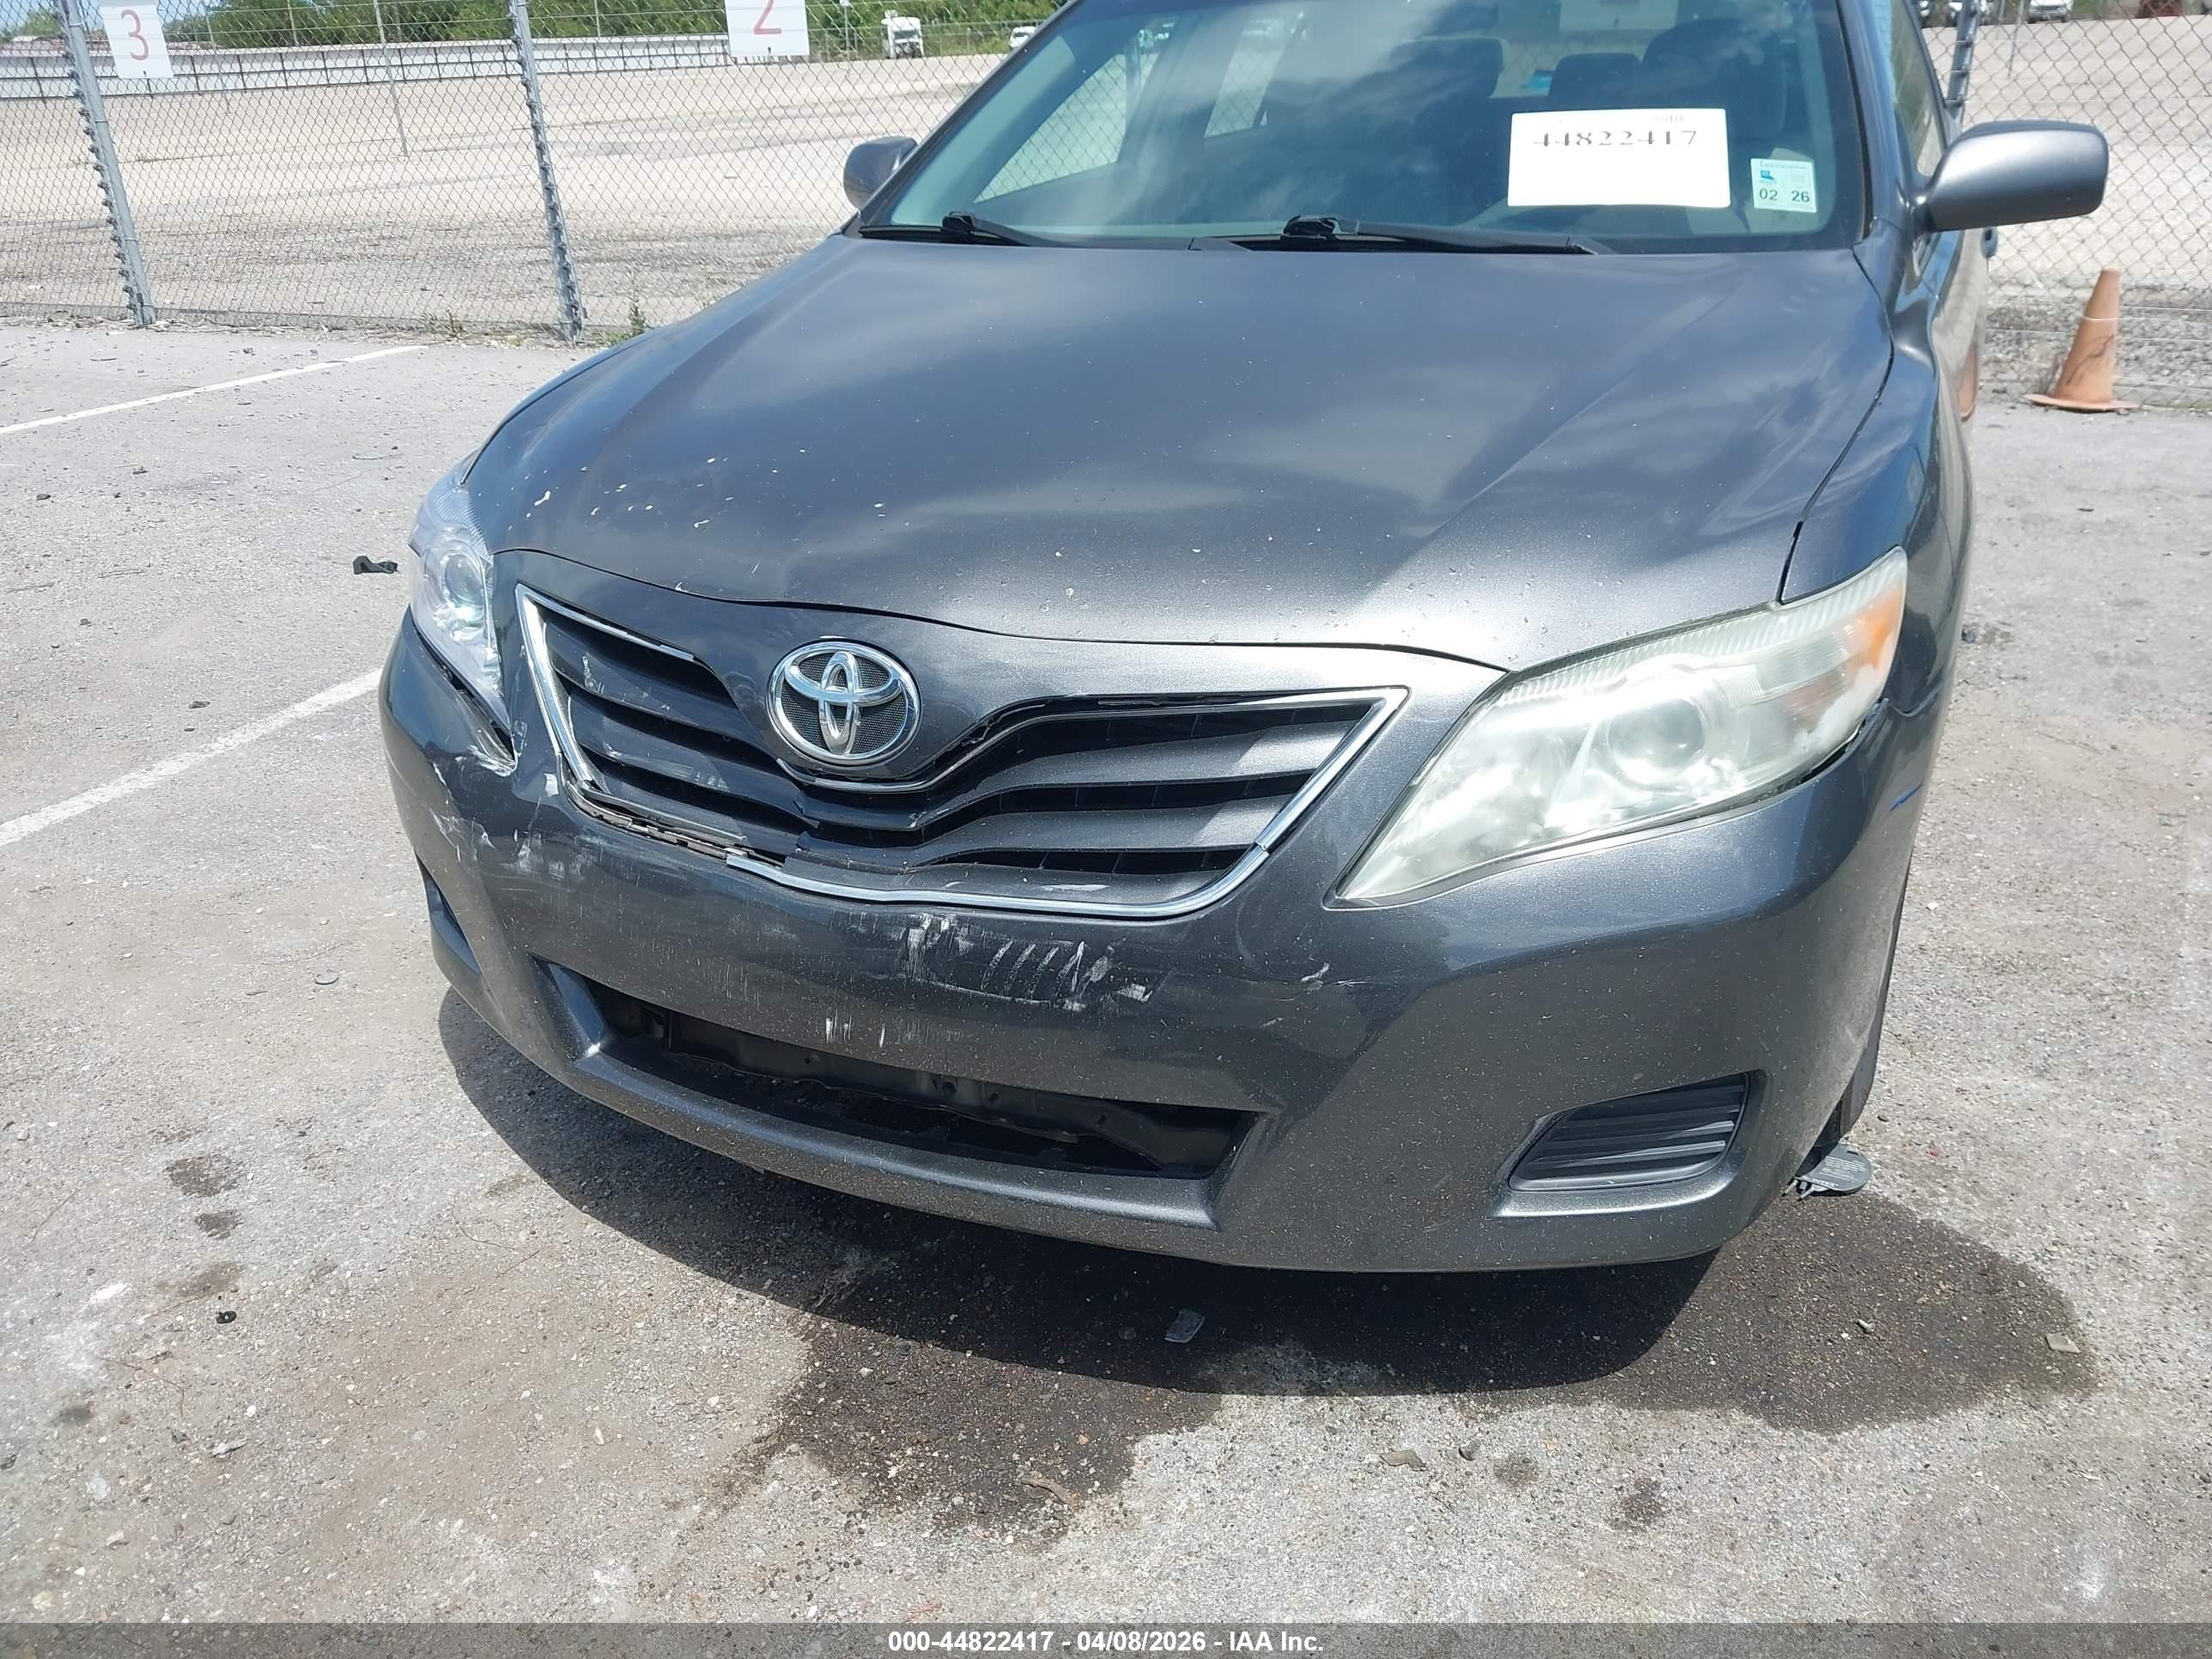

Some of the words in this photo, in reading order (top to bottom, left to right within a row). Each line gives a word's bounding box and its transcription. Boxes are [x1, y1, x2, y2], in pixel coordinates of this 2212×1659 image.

[120, 9, 149, 61] 3
[1534, 130, 1698, 147] 44822417
[1759, 188, 1779, 201] 02
[1791, 190, 1811, 203] 26
